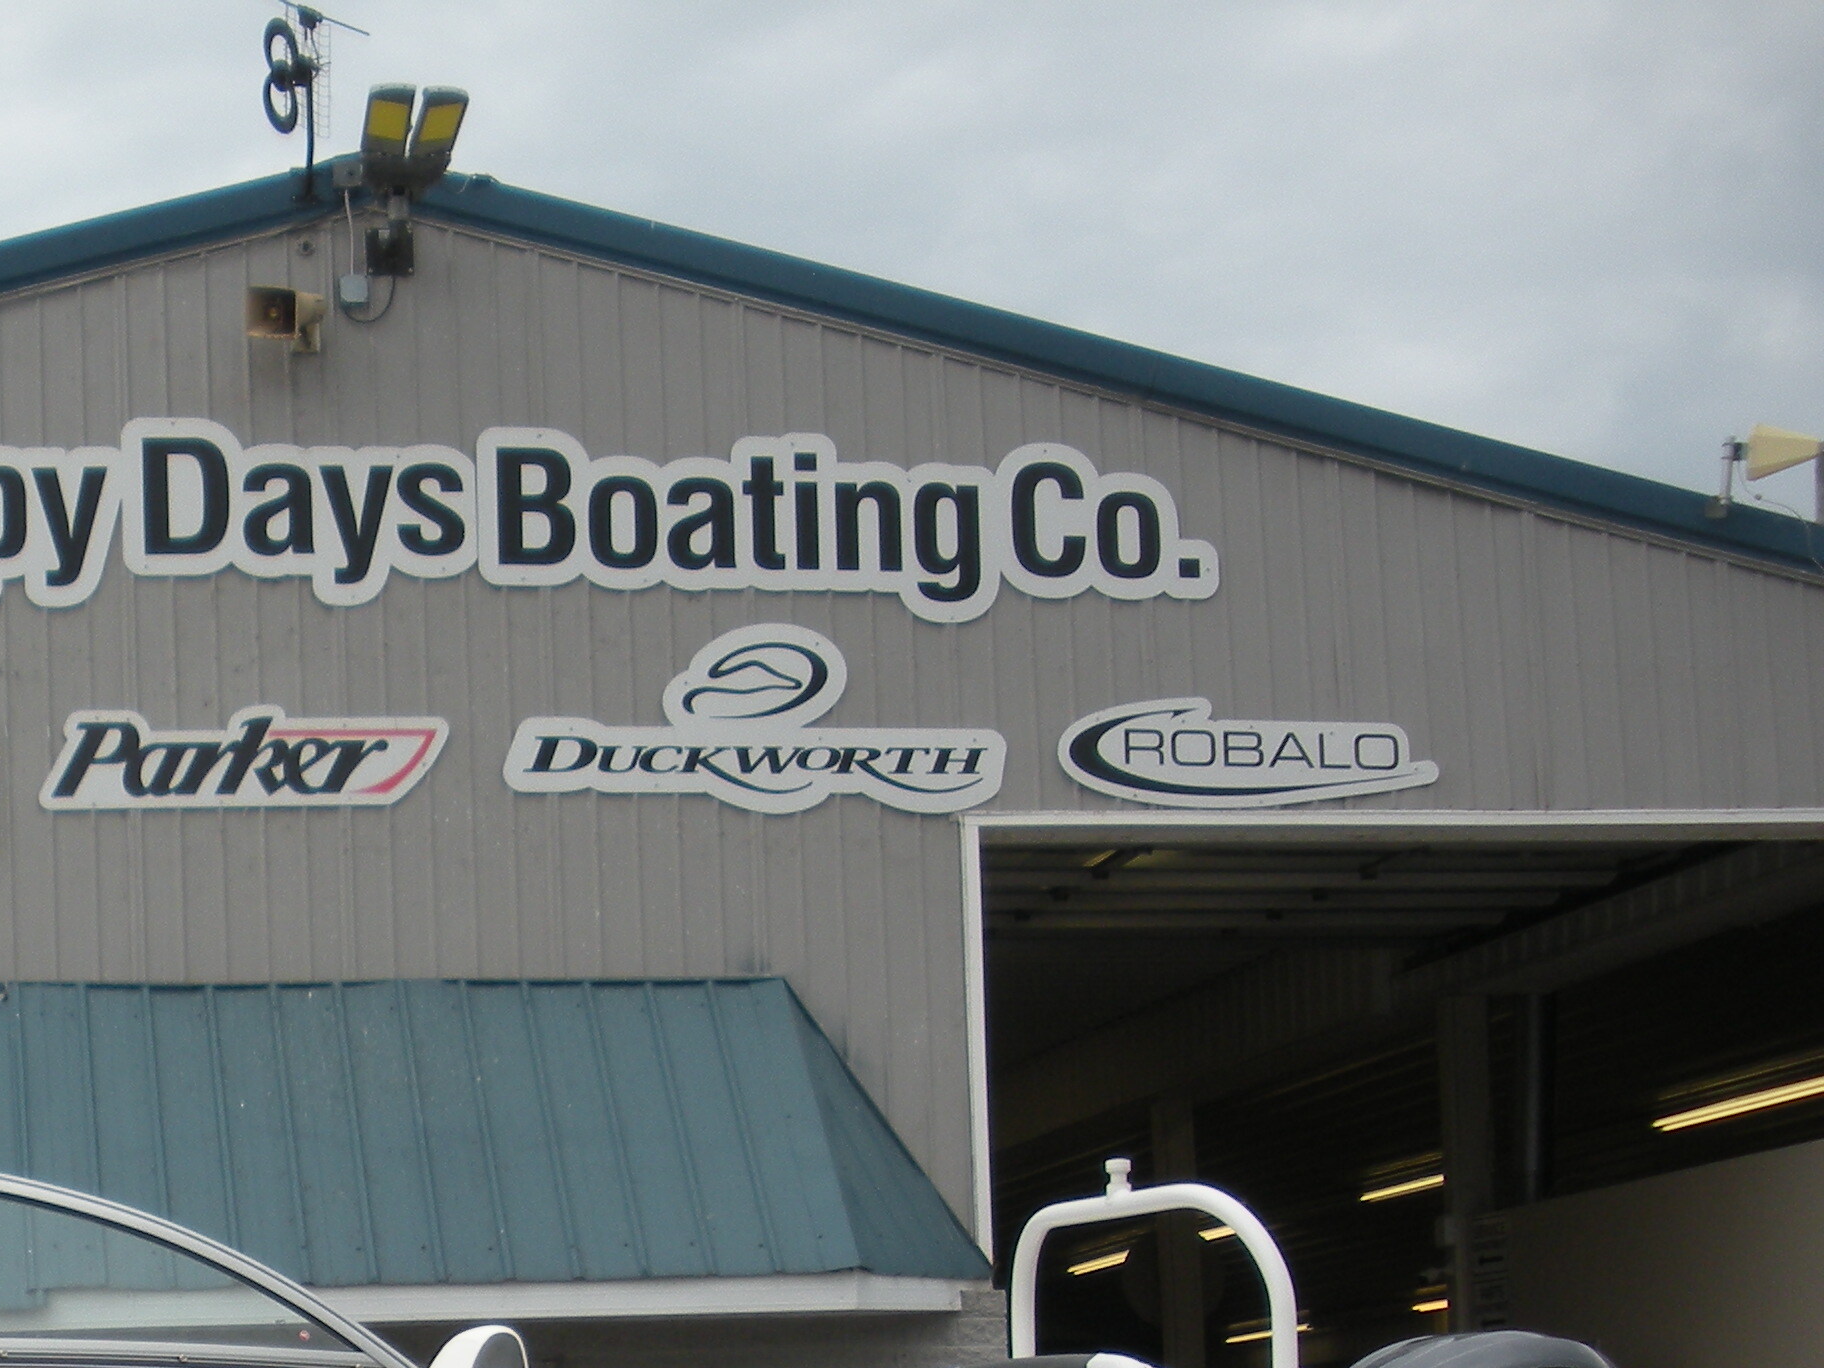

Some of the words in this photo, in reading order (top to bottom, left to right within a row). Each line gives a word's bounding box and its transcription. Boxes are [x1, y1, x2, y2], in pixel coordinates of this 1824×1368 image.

[141, 436, 466, 585] Days
[495, 445, 980, 603] Boating
[1009, 460, 1201, 579] Co.
[51, 715, 390, 799] Parker
[522, 734, 988, 793] DUCKWORTH
[1123, 727, 1400, 771] ROBALO
